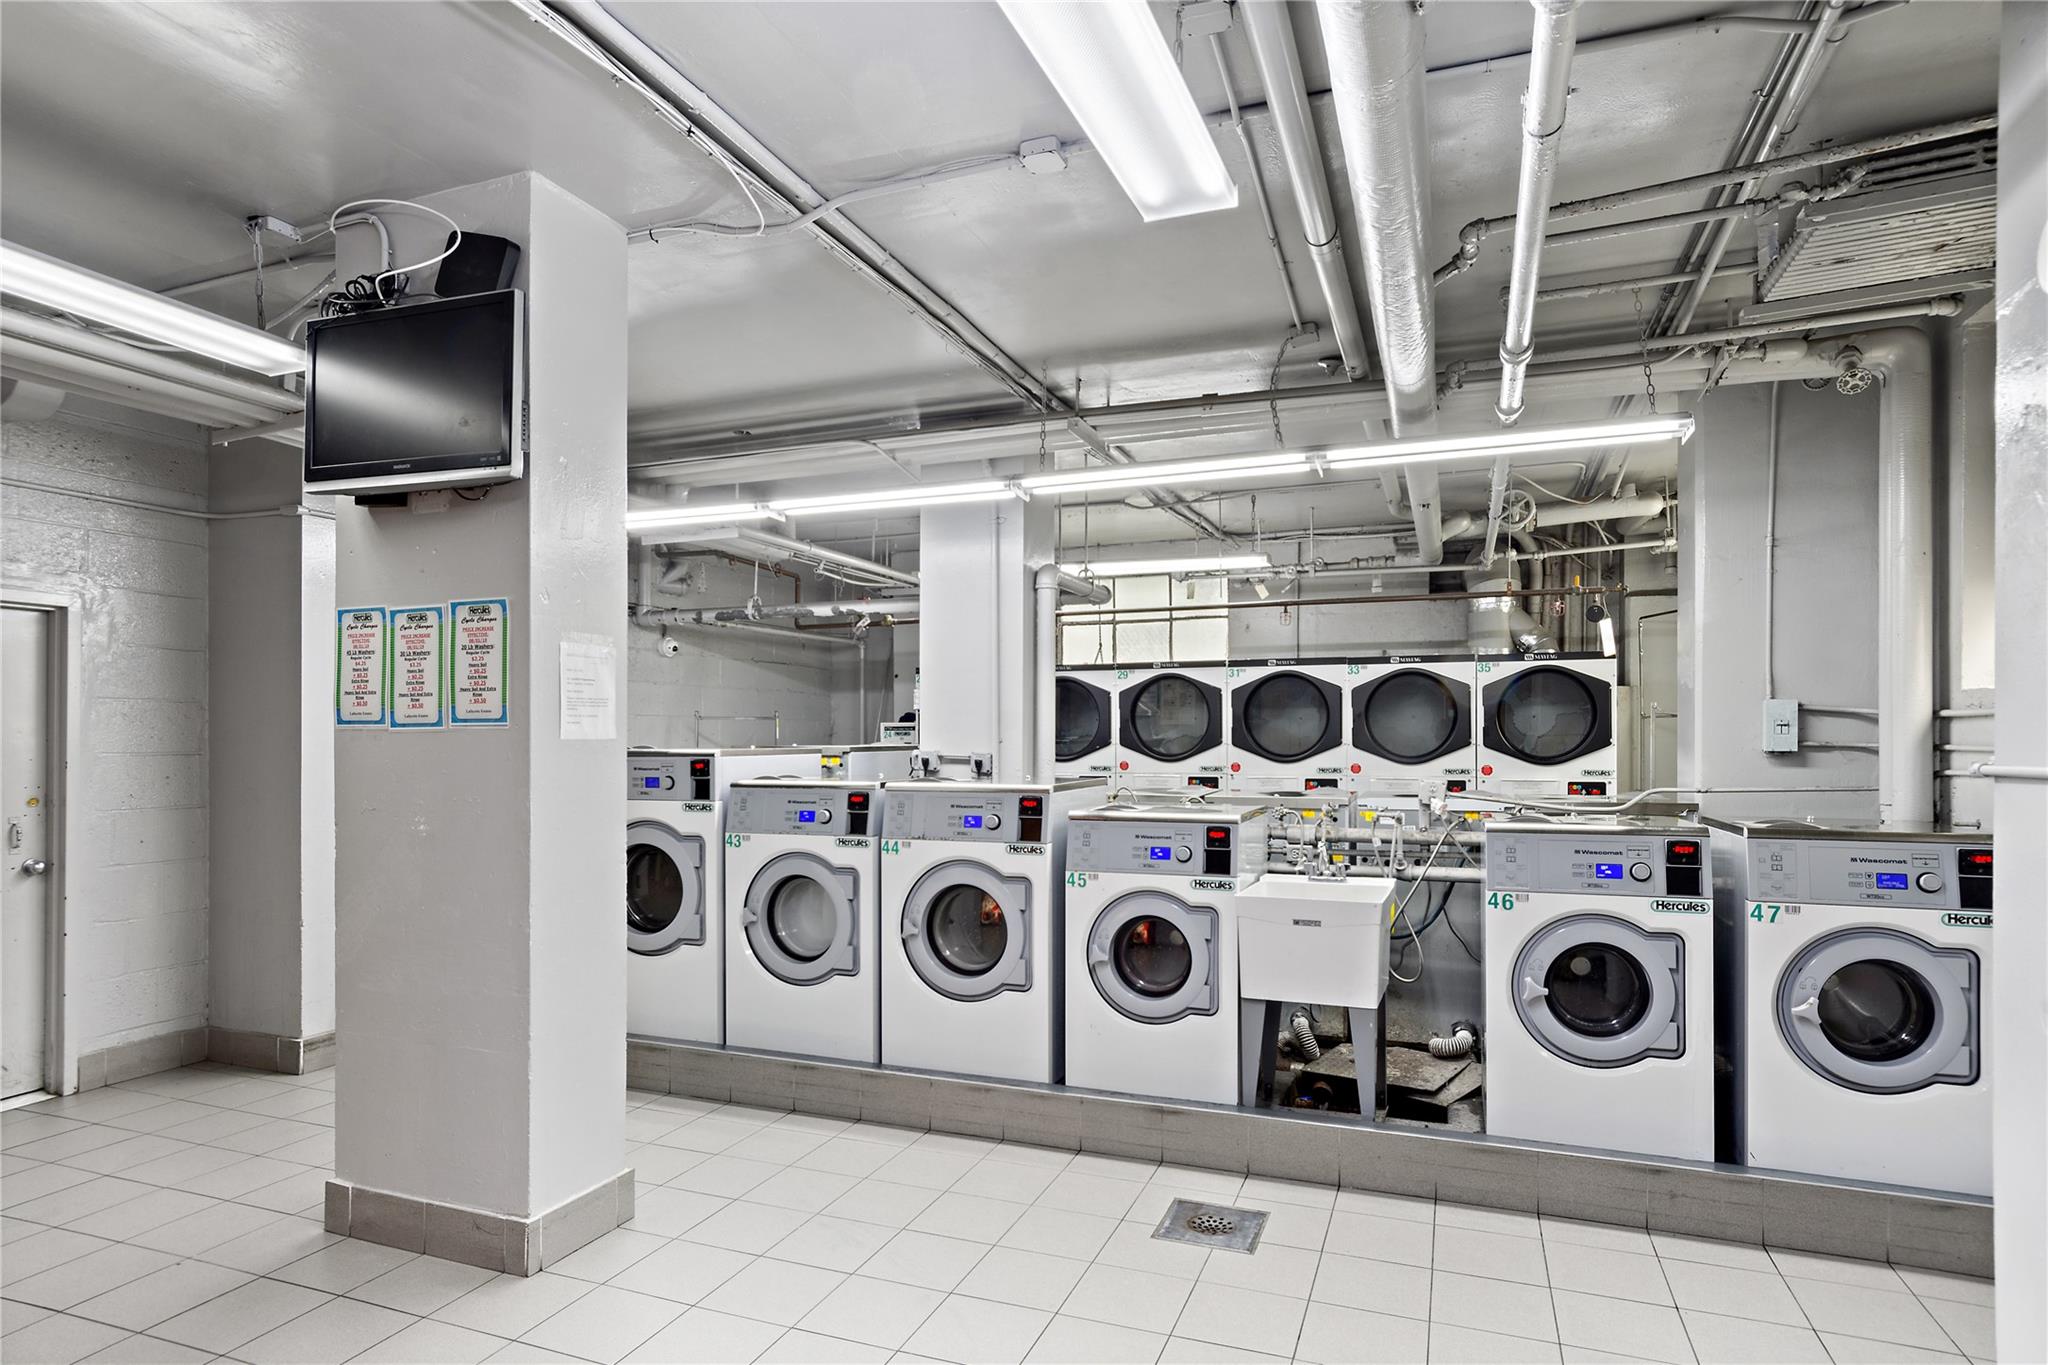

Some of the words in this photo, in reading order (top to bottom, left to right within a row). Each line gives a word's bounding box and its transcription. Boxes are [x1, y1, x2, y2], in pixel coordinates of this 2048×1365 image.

[1228, 668, 1240, 678] 31
[1348, 666, 1360, 675] 33
[1478, 664, 1491, 673] 35
[1117, 671, 1128, 680] 29
[684, 803, 712, 812] Hercules
[726, 834, 742, 848] 43
[838, 838, 869, 848] Hercules
[882, 840, 900, 855] 44
[1009, 844, 1044, 855] Hercules
[1858, 857, 1908, 866] Wascomat
[1066, 872, 1087, 888] 45
[1194, 880, 1233, 890] Hercules
[1488, 892, 1514, 910] 46
[1655, 900, 1706, 912] Hercules
[1750, 904, 1781, 924] 47
[1948, 914, 1993, 926] Hercul
